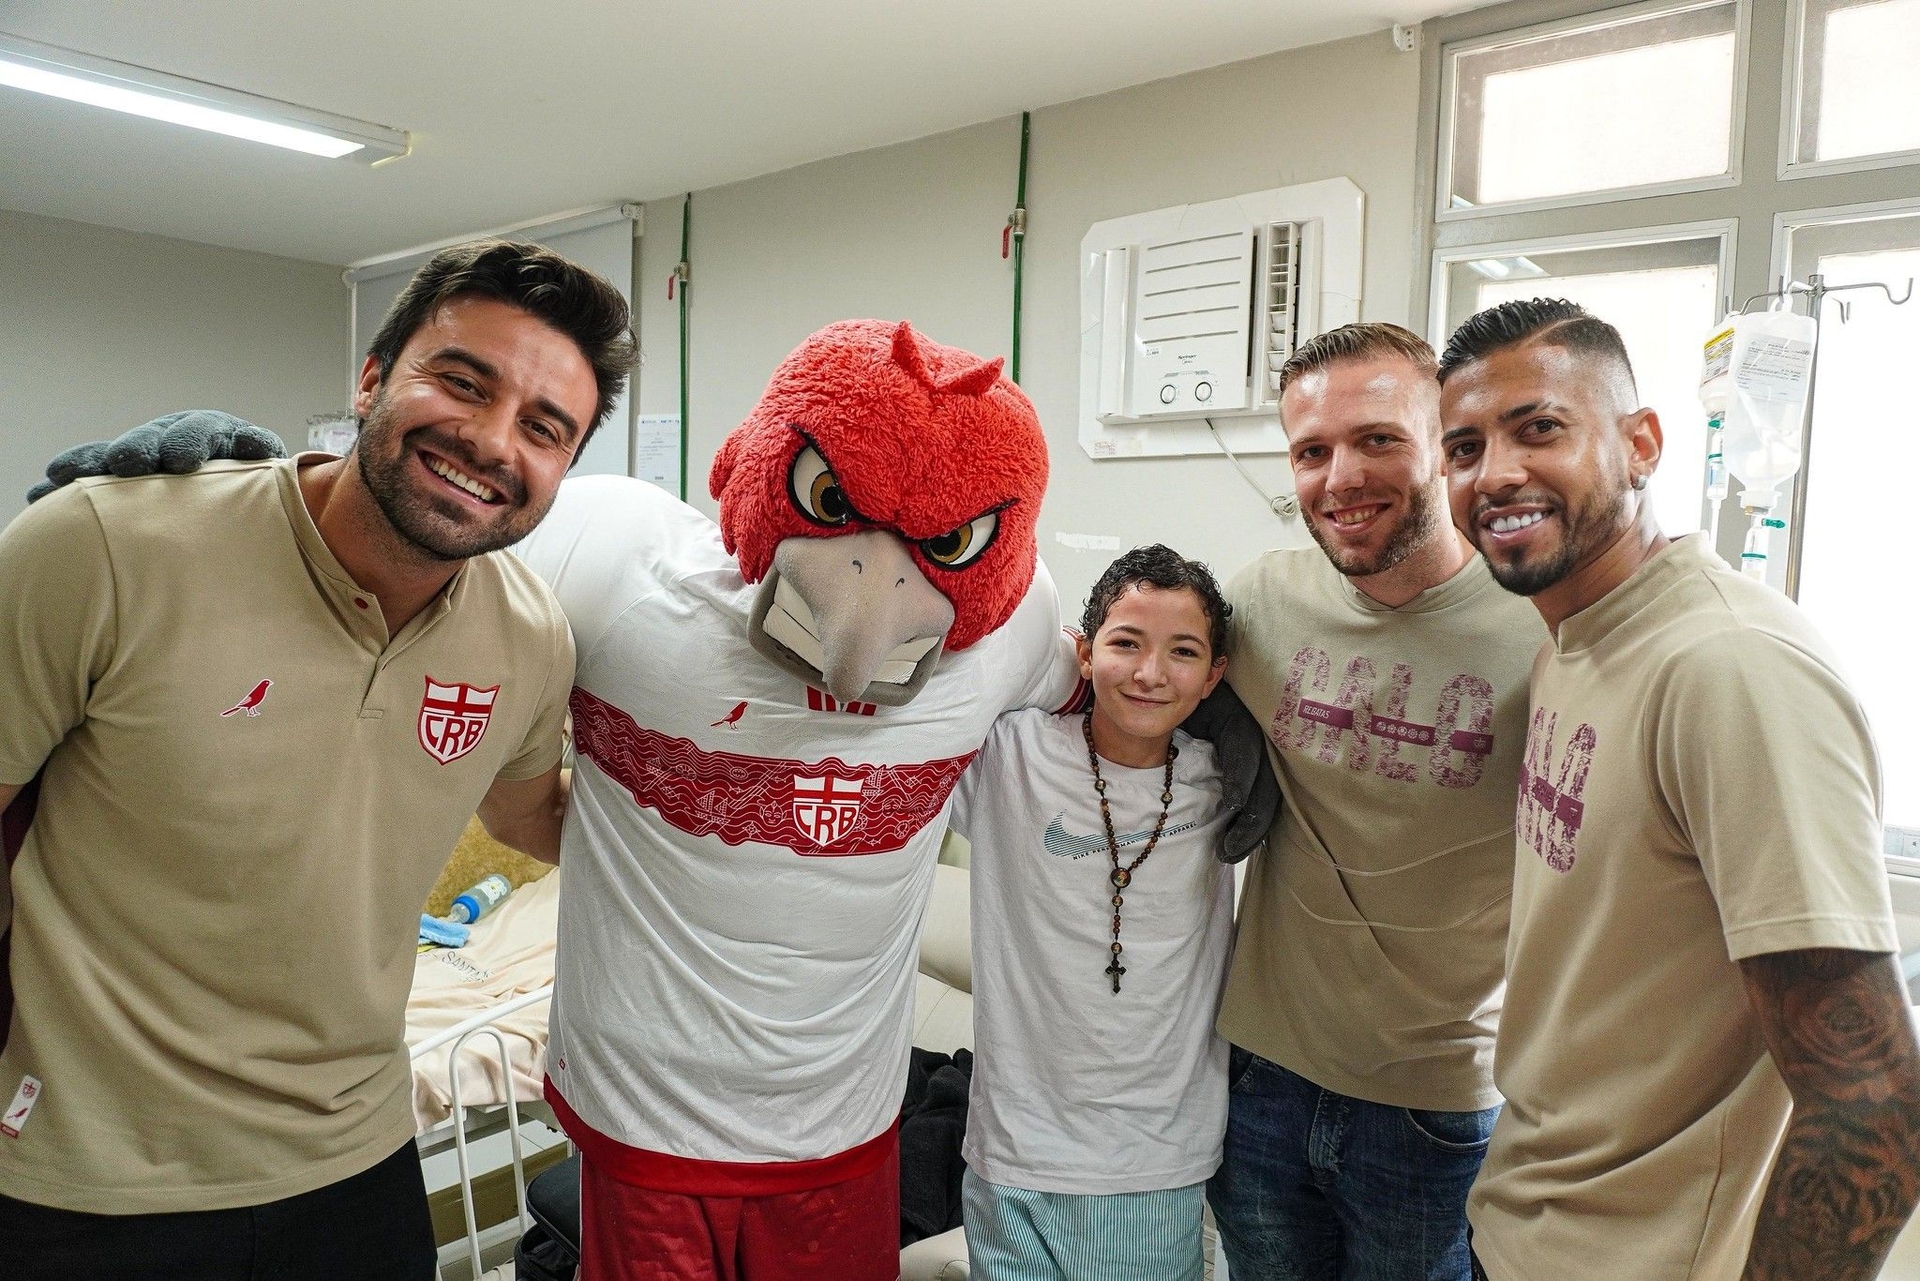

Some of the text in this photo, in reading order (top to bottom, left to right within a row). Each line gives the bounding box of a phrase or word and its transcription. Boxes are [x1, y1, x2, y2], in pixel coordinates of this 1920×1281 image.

[1303, 704, 1331, 719] REGATAS
[425, 714, 484, 757] CRB
[795, 804, 858, 845] CRB
[1072, 852, 1089, 861] NIKE
[1169, 822, 1197, 836] APPAREL
